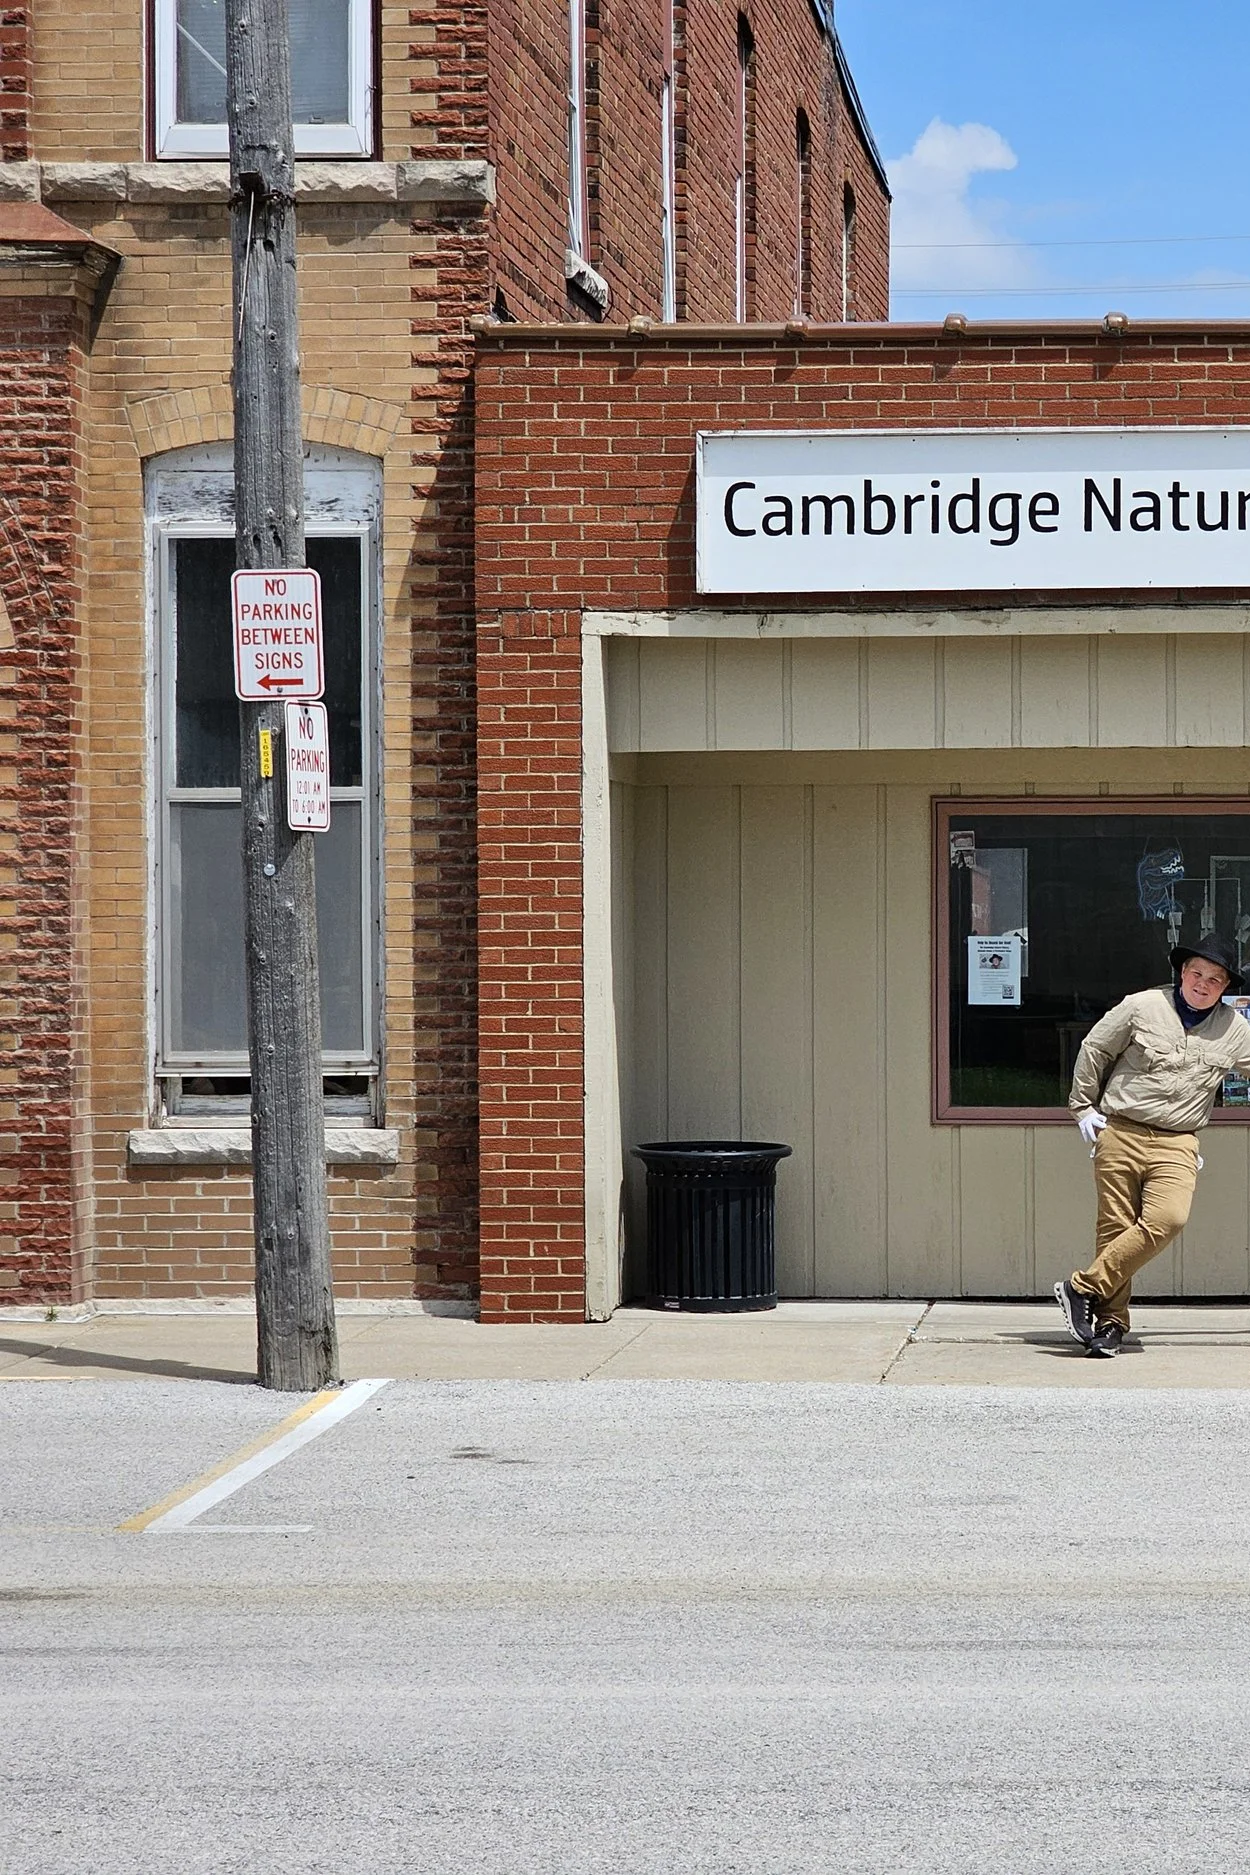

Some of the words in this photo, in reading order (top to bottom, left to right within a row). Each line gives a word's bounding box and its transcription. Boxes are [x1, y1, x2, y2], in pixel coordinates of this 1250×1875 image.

[724, 477, 1060, 547] Cambridge
[265, 579, 287, 596] NO
[241, 603, 313, 620] PARKING
[241, 628, 315, 645] BETWEEN
[255, 652, 303, 669] SIGNS
[299, 717, 314, 740] NO
[291, 749, 325, 773] PARKING
[297, 781, 310, 794] 12:01
[313, 781, 321, 795] AM
[293, 799, 299, 813] TO
[319, 800, 326, 814] AM
